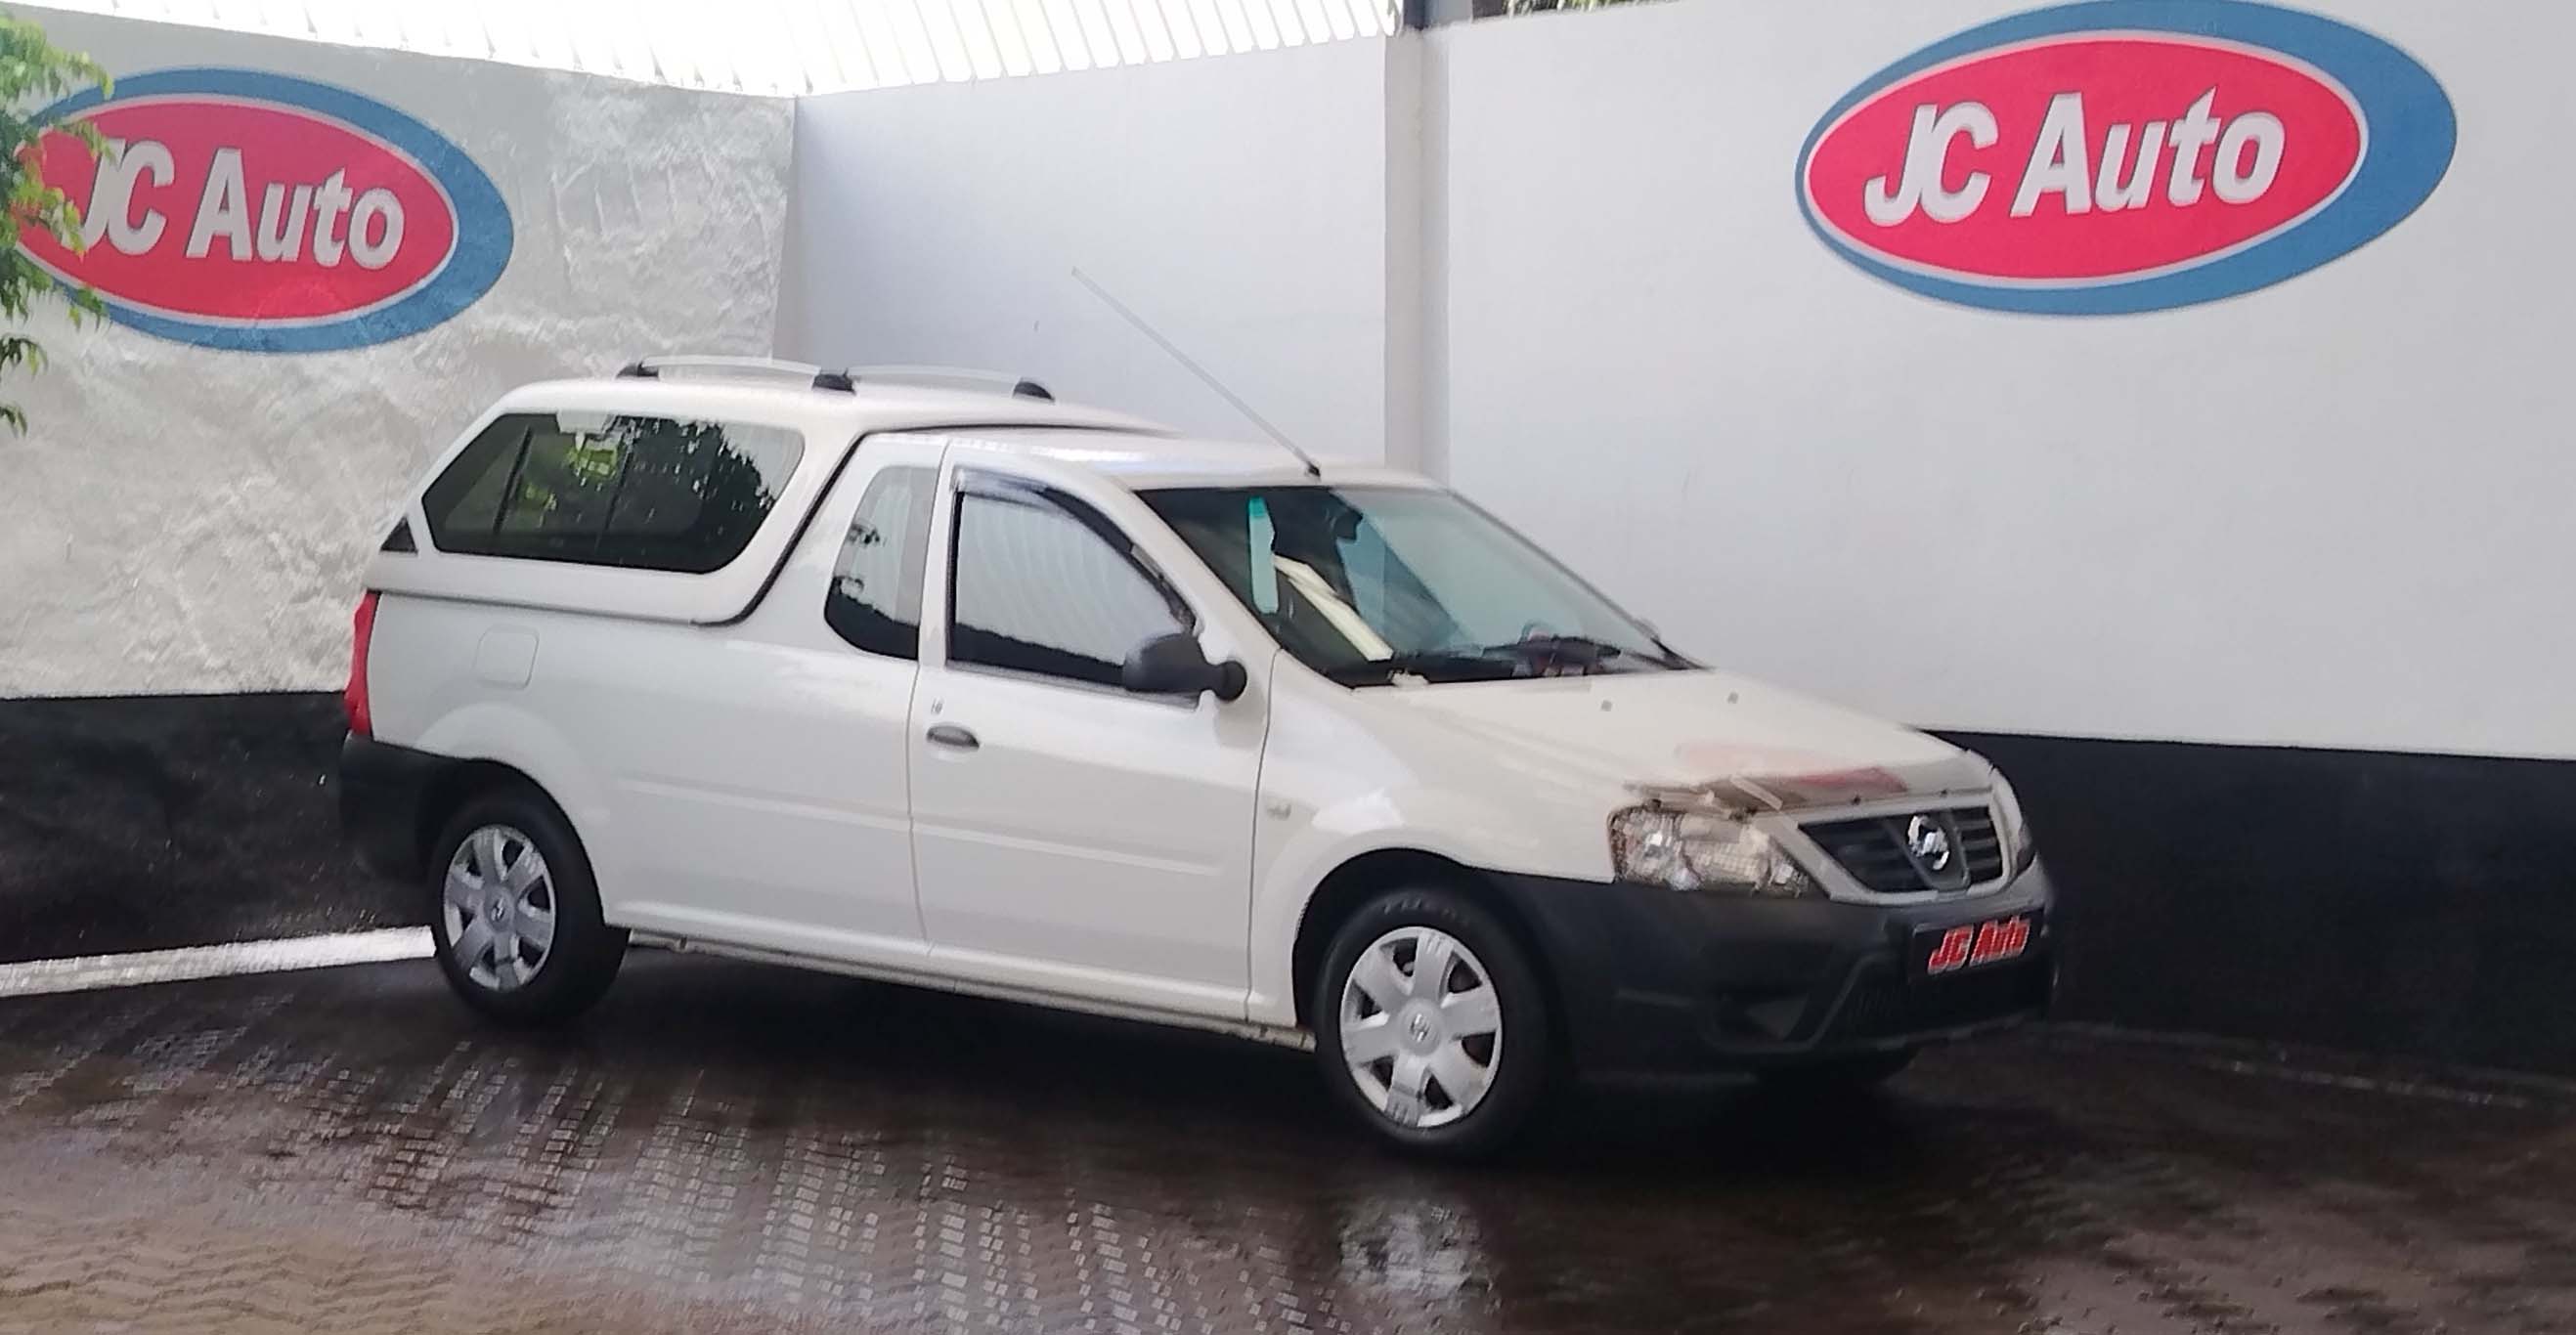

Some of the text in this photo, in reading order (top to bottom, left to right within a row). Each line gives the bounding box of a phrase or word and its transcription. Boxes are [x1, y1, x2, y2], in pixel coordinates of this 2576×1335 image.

[66, 138, 406, 269] JC Auto
[1863, 85, 2286, 227] JC Auto
[1928, 915, 2030, 974] JC Auto
